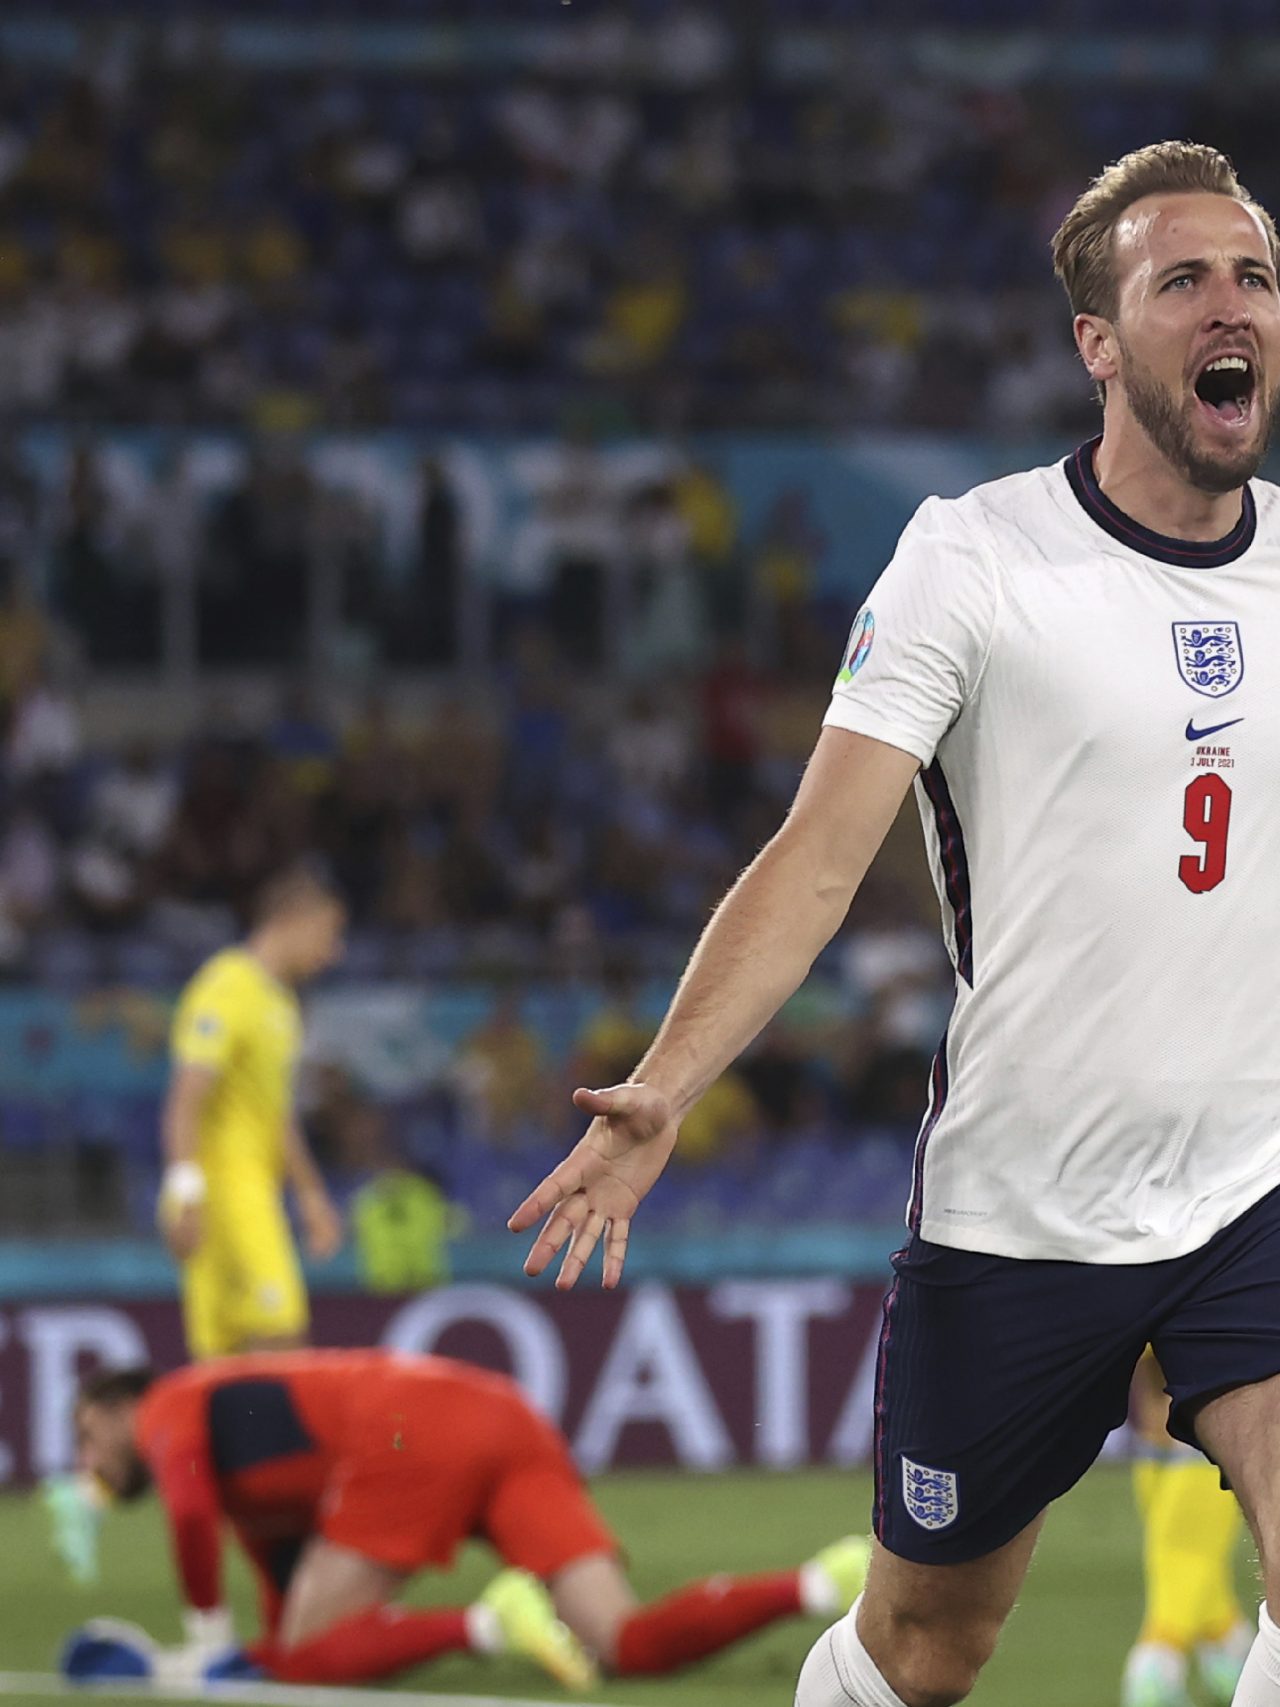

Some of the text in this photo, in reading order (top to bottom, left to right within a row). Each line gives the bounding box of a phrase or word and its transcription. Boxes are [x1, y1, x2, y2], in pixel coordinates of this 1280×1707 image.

[1196, 757, 1215, 767] JULY
[1217, 758, 1235, 768] 2021
[1178, 772, 1232, 894] 9
